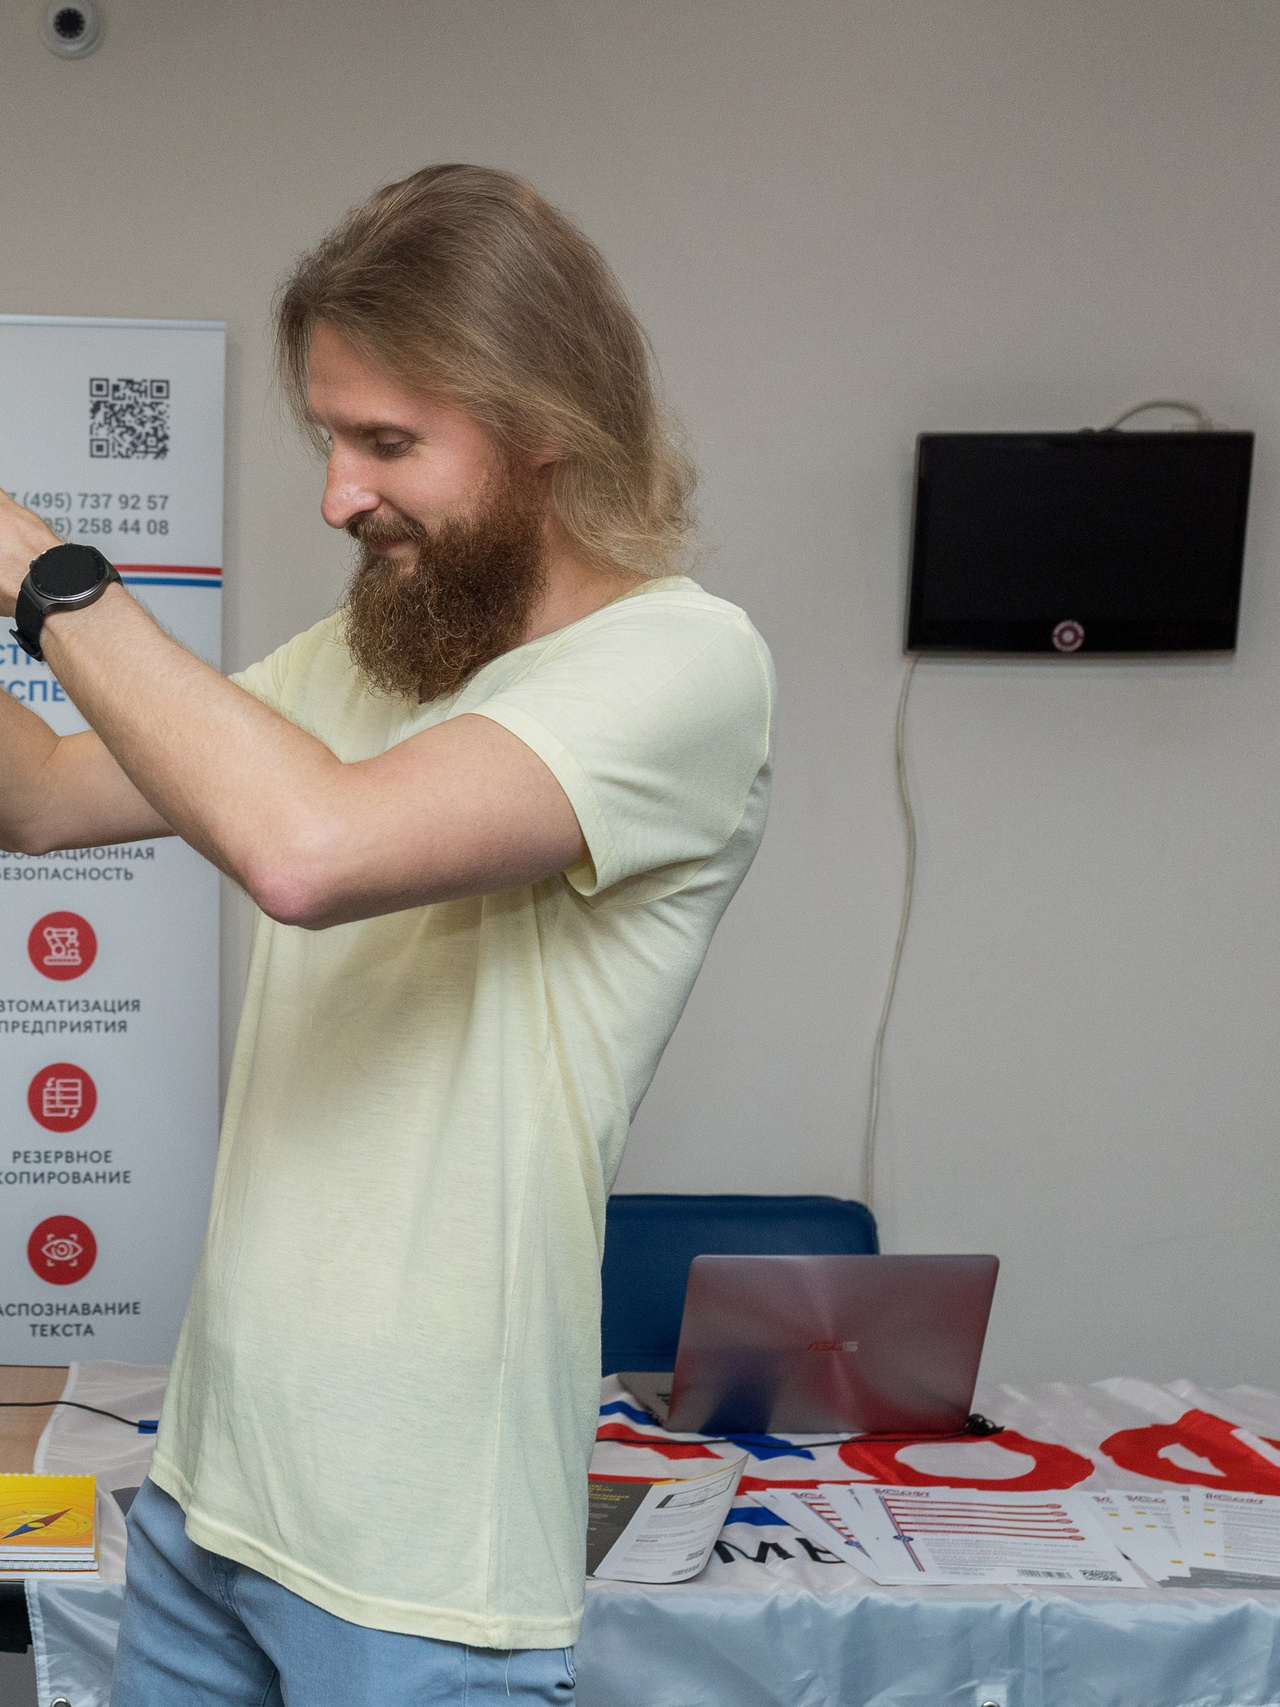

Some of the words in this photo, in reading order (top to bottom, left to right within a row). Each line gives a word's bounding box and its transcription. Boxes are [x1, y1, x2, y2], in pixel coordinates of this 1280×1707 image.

[23, 490, 72, 512] (495)
[78, 492, 113, 509] 737
[119, 494, 141, 510] 92
[147, 494, 170, 511] 57
[78, 518, 113, 534] 258
[119, 519, 141, 535] 44
[147, 519, 170, 536] 08
[12, 1150, 113, 1164] РЕЗЕРВНОЕ
[29, 1323, 95, 1338] ТЕКСТА
